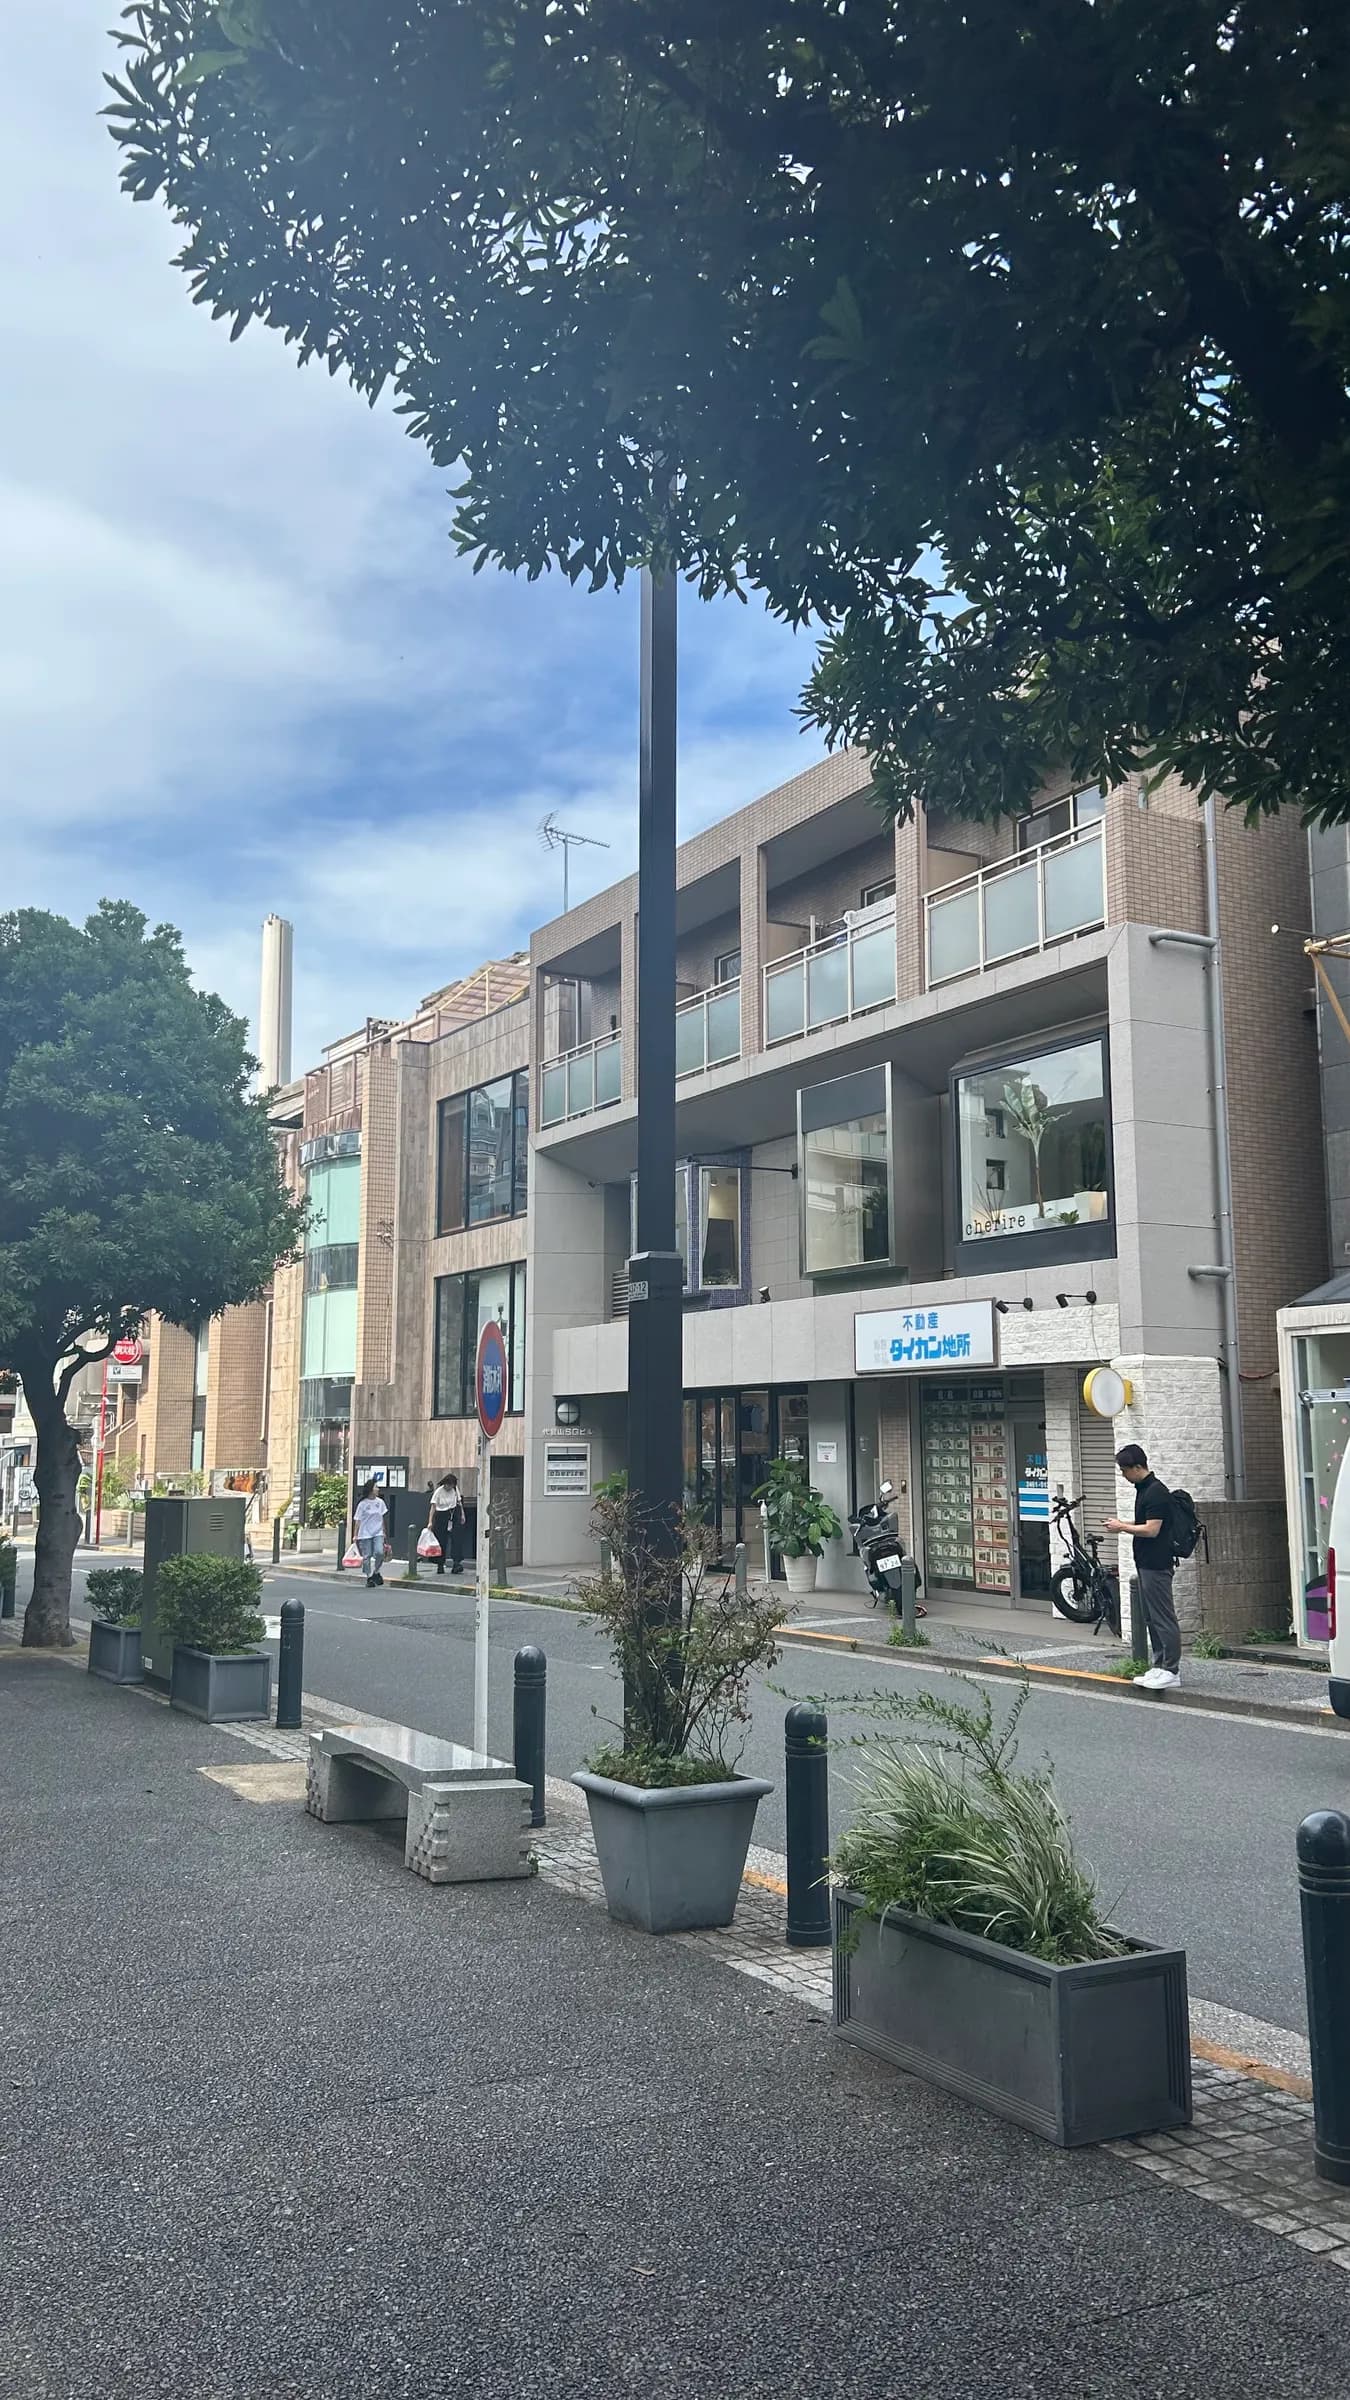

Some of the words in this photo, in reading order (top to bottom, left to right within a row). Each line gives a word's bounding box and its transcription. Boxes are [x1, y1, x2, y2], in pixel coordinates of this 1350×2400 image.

[965, 1214, 1026, 1236] cherire
[902, 1312, 939, 1331] 不動産
[889, 1333, 970, 1361] ダイカン地所
